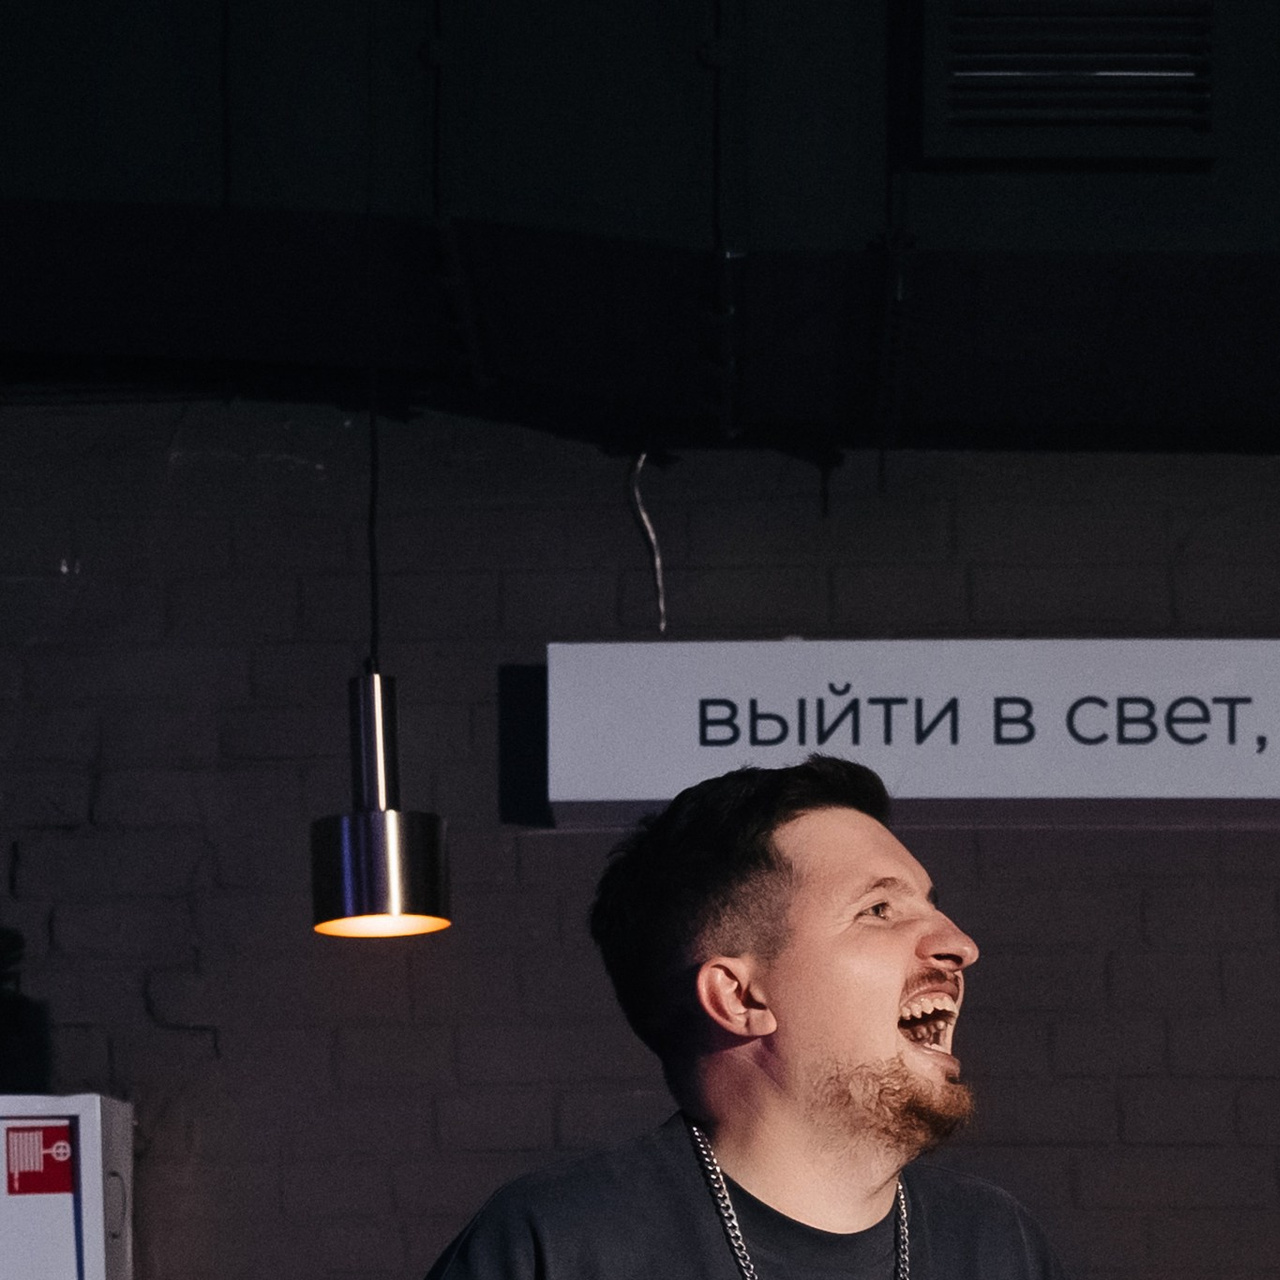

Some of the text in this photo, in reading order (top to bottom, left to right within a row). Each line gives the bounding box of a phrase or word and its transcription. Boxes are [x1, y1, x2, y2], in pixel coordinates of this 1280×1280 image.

[698, 682, 960, 748] выйти
[993, 696, 1036, 746] в
[1065, 695, 1268, 754] свет,
